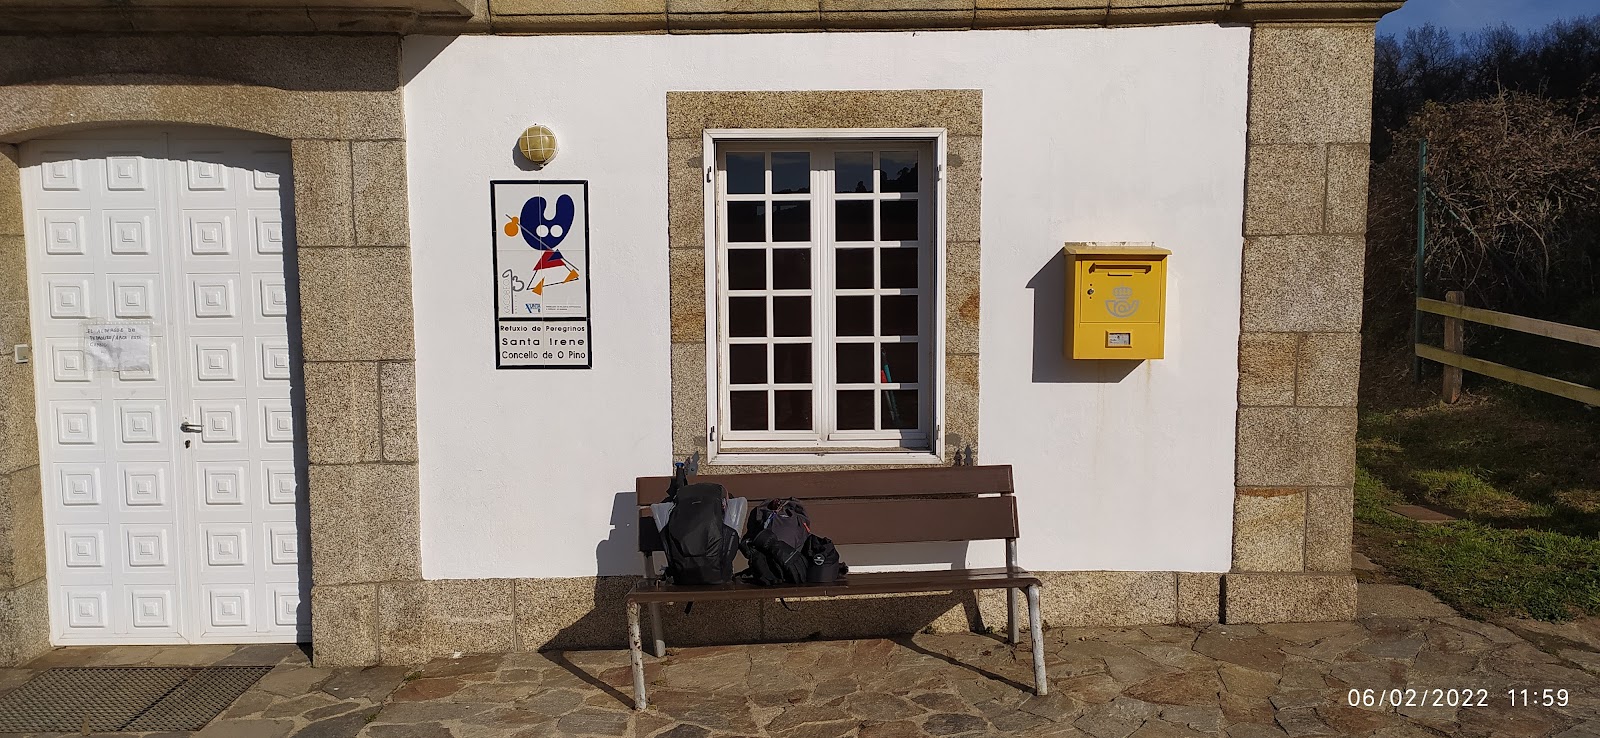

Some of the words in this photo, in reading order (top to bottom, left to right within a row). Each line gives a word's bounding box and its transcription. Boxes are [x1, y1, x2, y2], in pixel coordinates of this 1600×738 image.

[545, 325, 585, 333] Peregrinos
[502, 338, 540, 346] Santa
[549, 338, 585, 346] Irene
[502, 351, 538, 359] Concello
[542, 351, 553, 359] de
[557, 351, 564, 359] O
[568, 351, 586, 359] Pino
